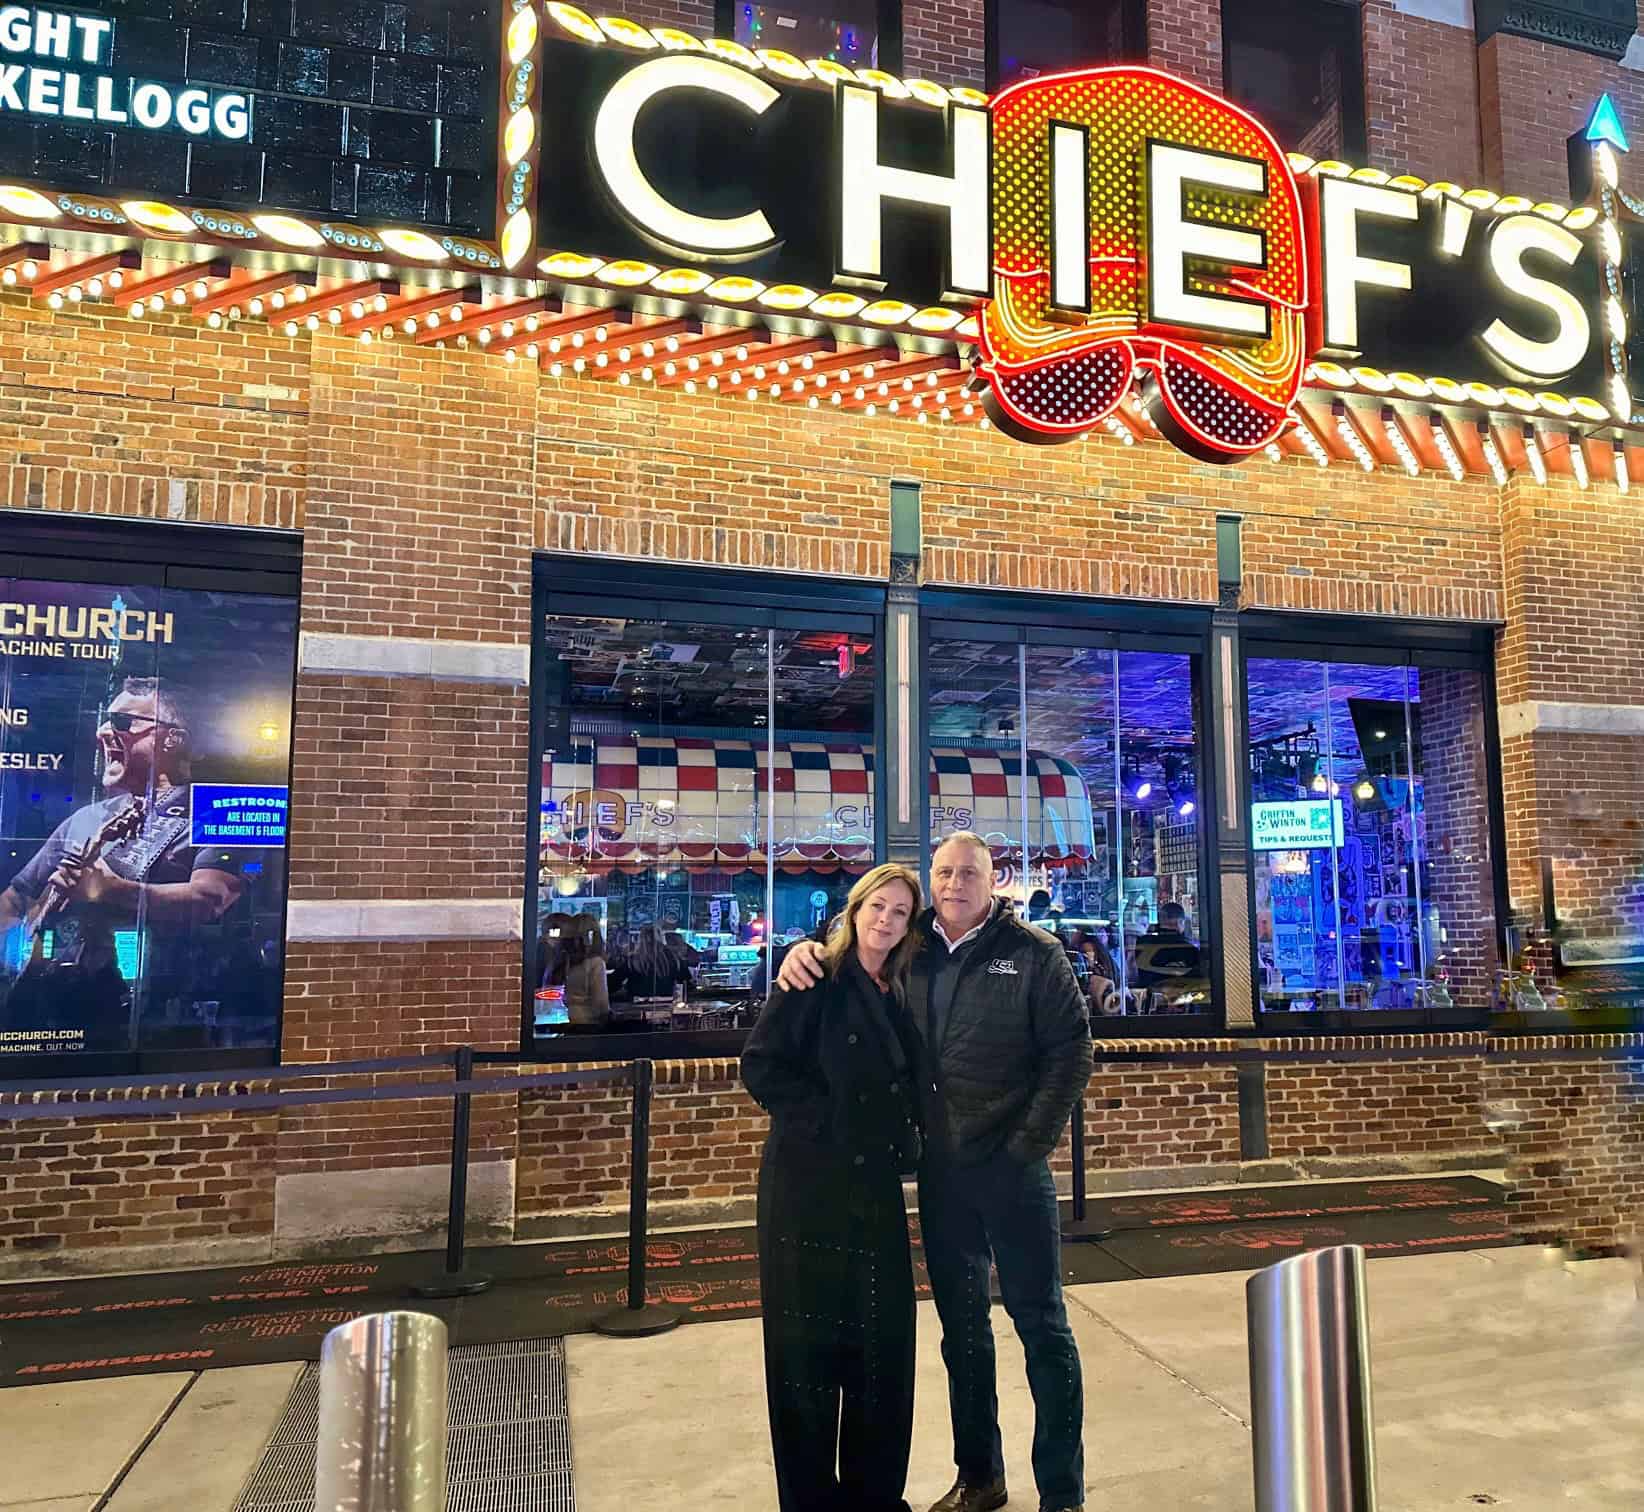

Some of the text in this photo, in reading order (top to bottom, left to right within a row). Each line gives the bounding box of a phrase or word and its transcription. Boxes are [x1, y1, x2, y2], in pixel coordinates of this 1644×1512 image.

[0, 6, 111, 63] GHT
[0, 63, 249, 139] KELLOGG
[592, 55, 1592, 382] CHIEF'S
[0, 602, 175, 644] CHURCH
[70, 642, 120, 661] TOUR
[0, 752, 64, 771] ESLEY
[212, 797, 288, 809] RESTROOM
[1268, 817, 1307, 829] WINTON
[1259, 836, 1279, 844] TIPS
[46, 1043, 64, 1051] OUT
[65, 1042, 85, 1050] NOW
[238, 1264, 379, 1284] REDEMPTION
[15, 1349, 216, 1376] ADMISSION
